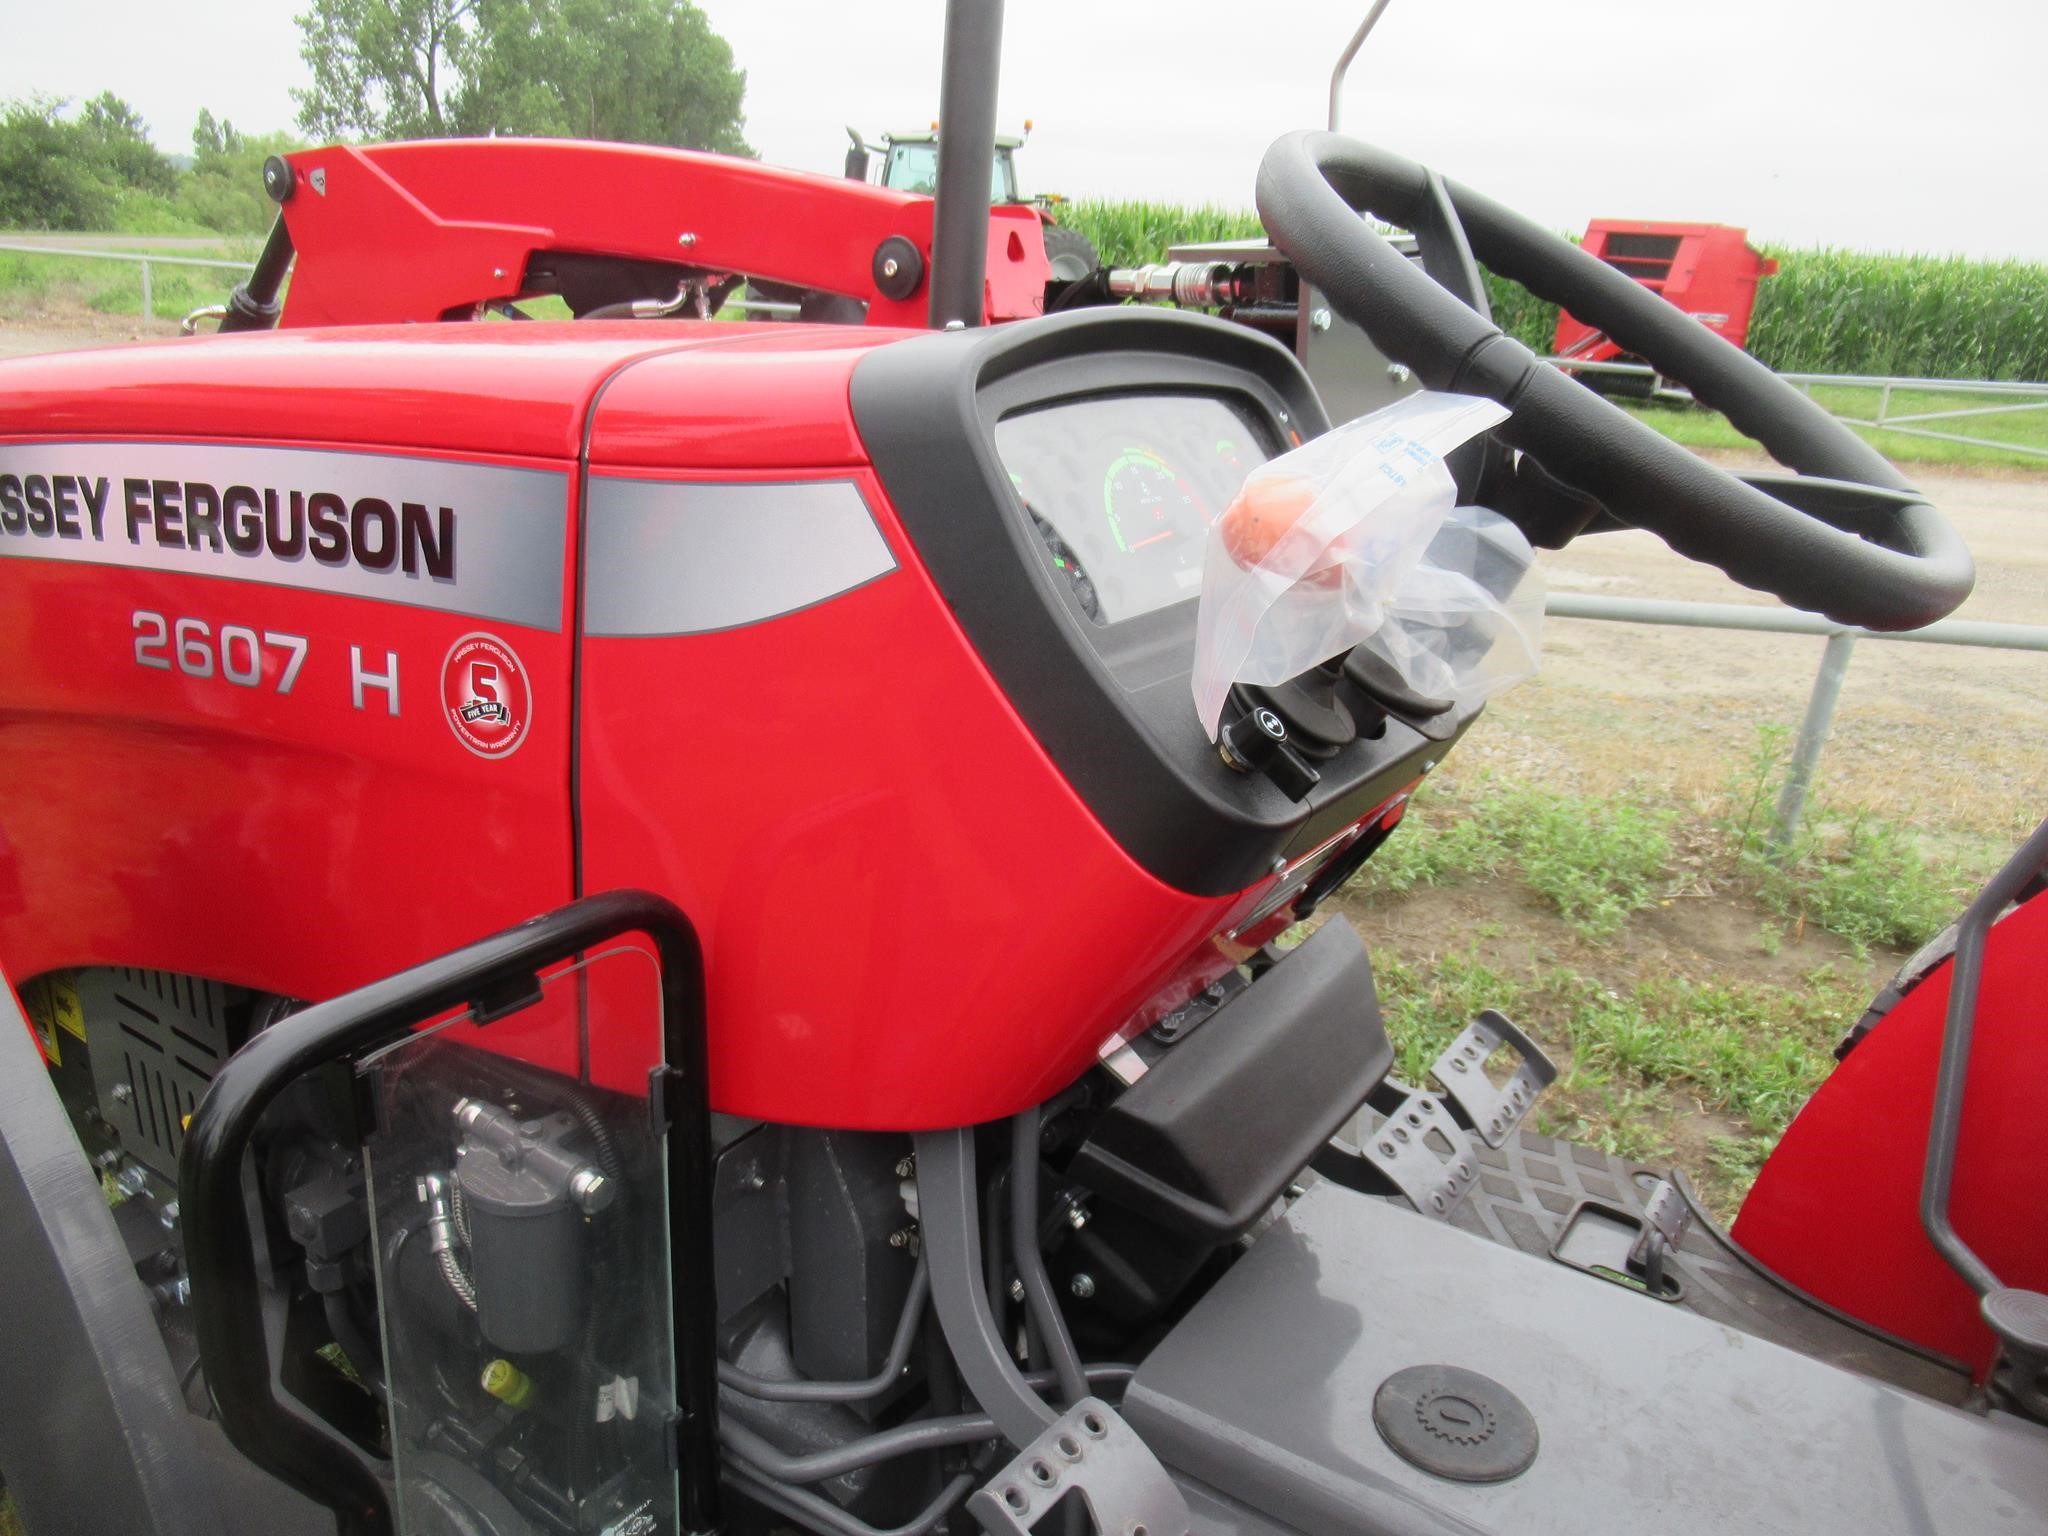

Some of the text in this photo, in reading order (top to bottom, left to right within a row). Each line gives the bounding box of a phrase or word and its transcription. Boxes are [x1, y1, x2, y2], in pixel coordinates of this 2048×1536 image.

[0, 474, 457, 585] SSEY FERGUSON
[131, 609, 401, 718] 2607 H
[454, 642, 516, 673] MASSEY FERGUSON
[451, 708, 522, 749] POWERTRAIN WARRANTY
[467, 703, 498, 719] FIVE YEAR
